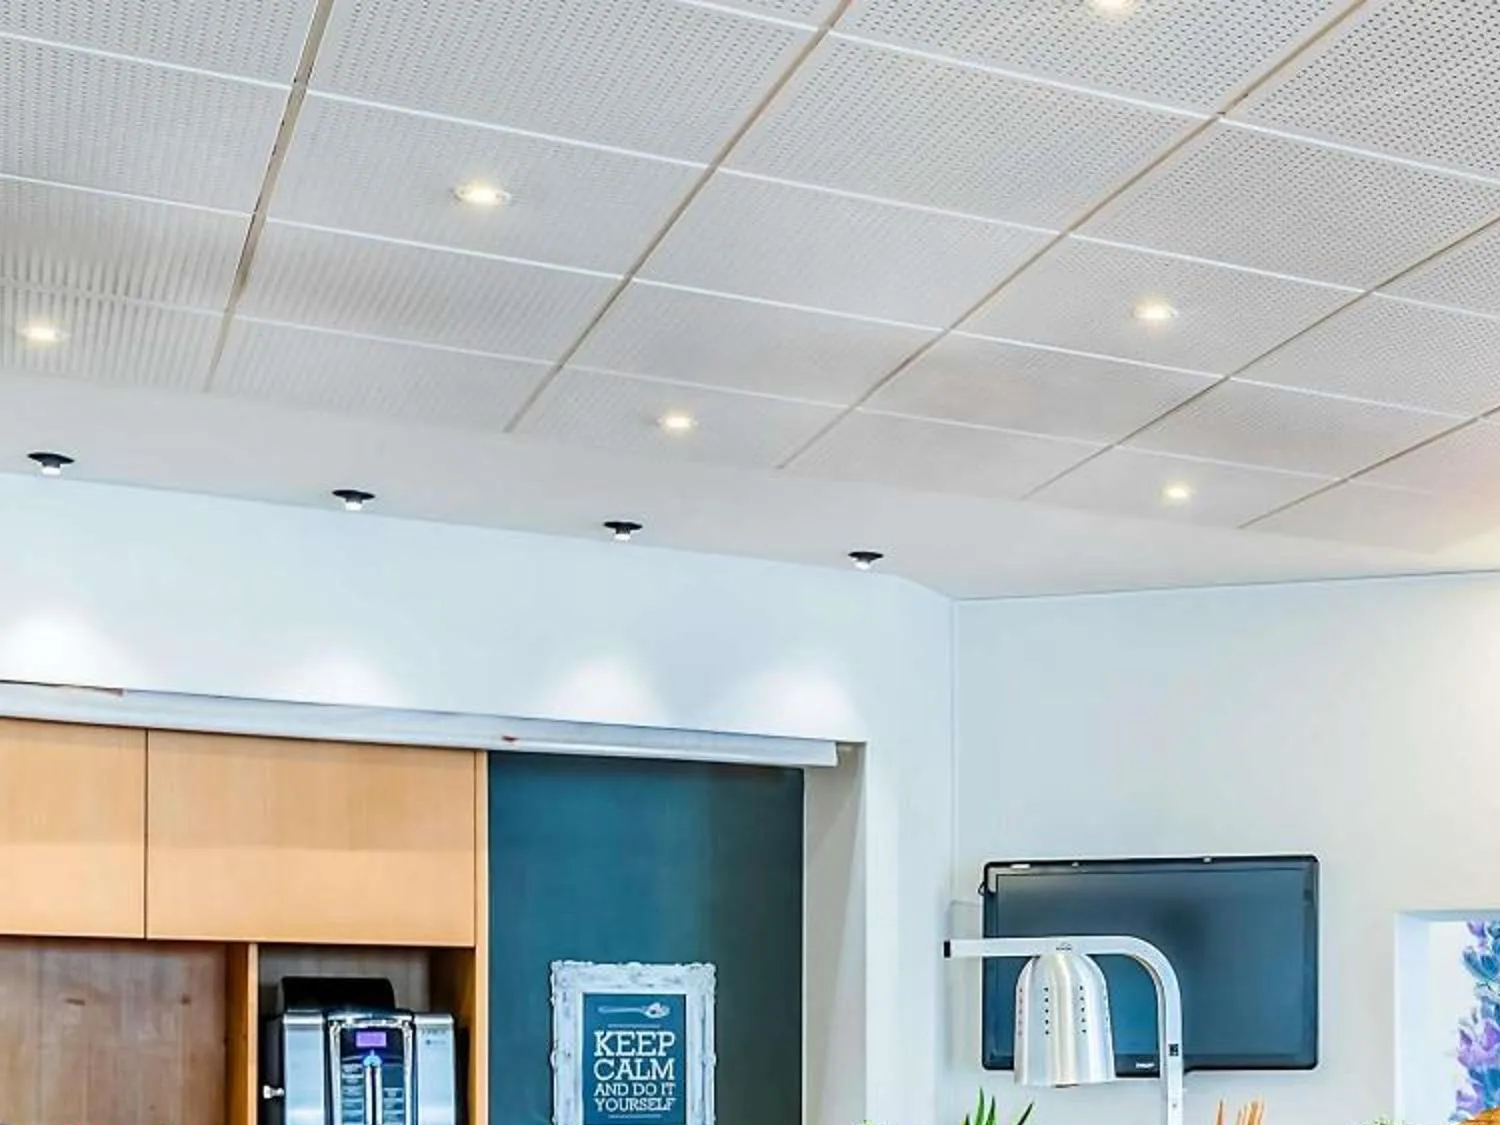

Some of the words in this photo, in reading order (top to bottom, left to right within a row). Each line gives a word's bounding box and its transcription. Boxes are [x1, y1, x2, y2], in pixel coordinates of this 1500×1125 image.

[593, 1030, 675, 1056] KEEP
[593, 1058, 675, 1080] CALM
[593, 1082, 629, 1096] AND
[632, 1082, 657, 1096] DO
[660, 1082, 676, 1096] IT
[593, 1097, 677, 1112] YOURSELF
